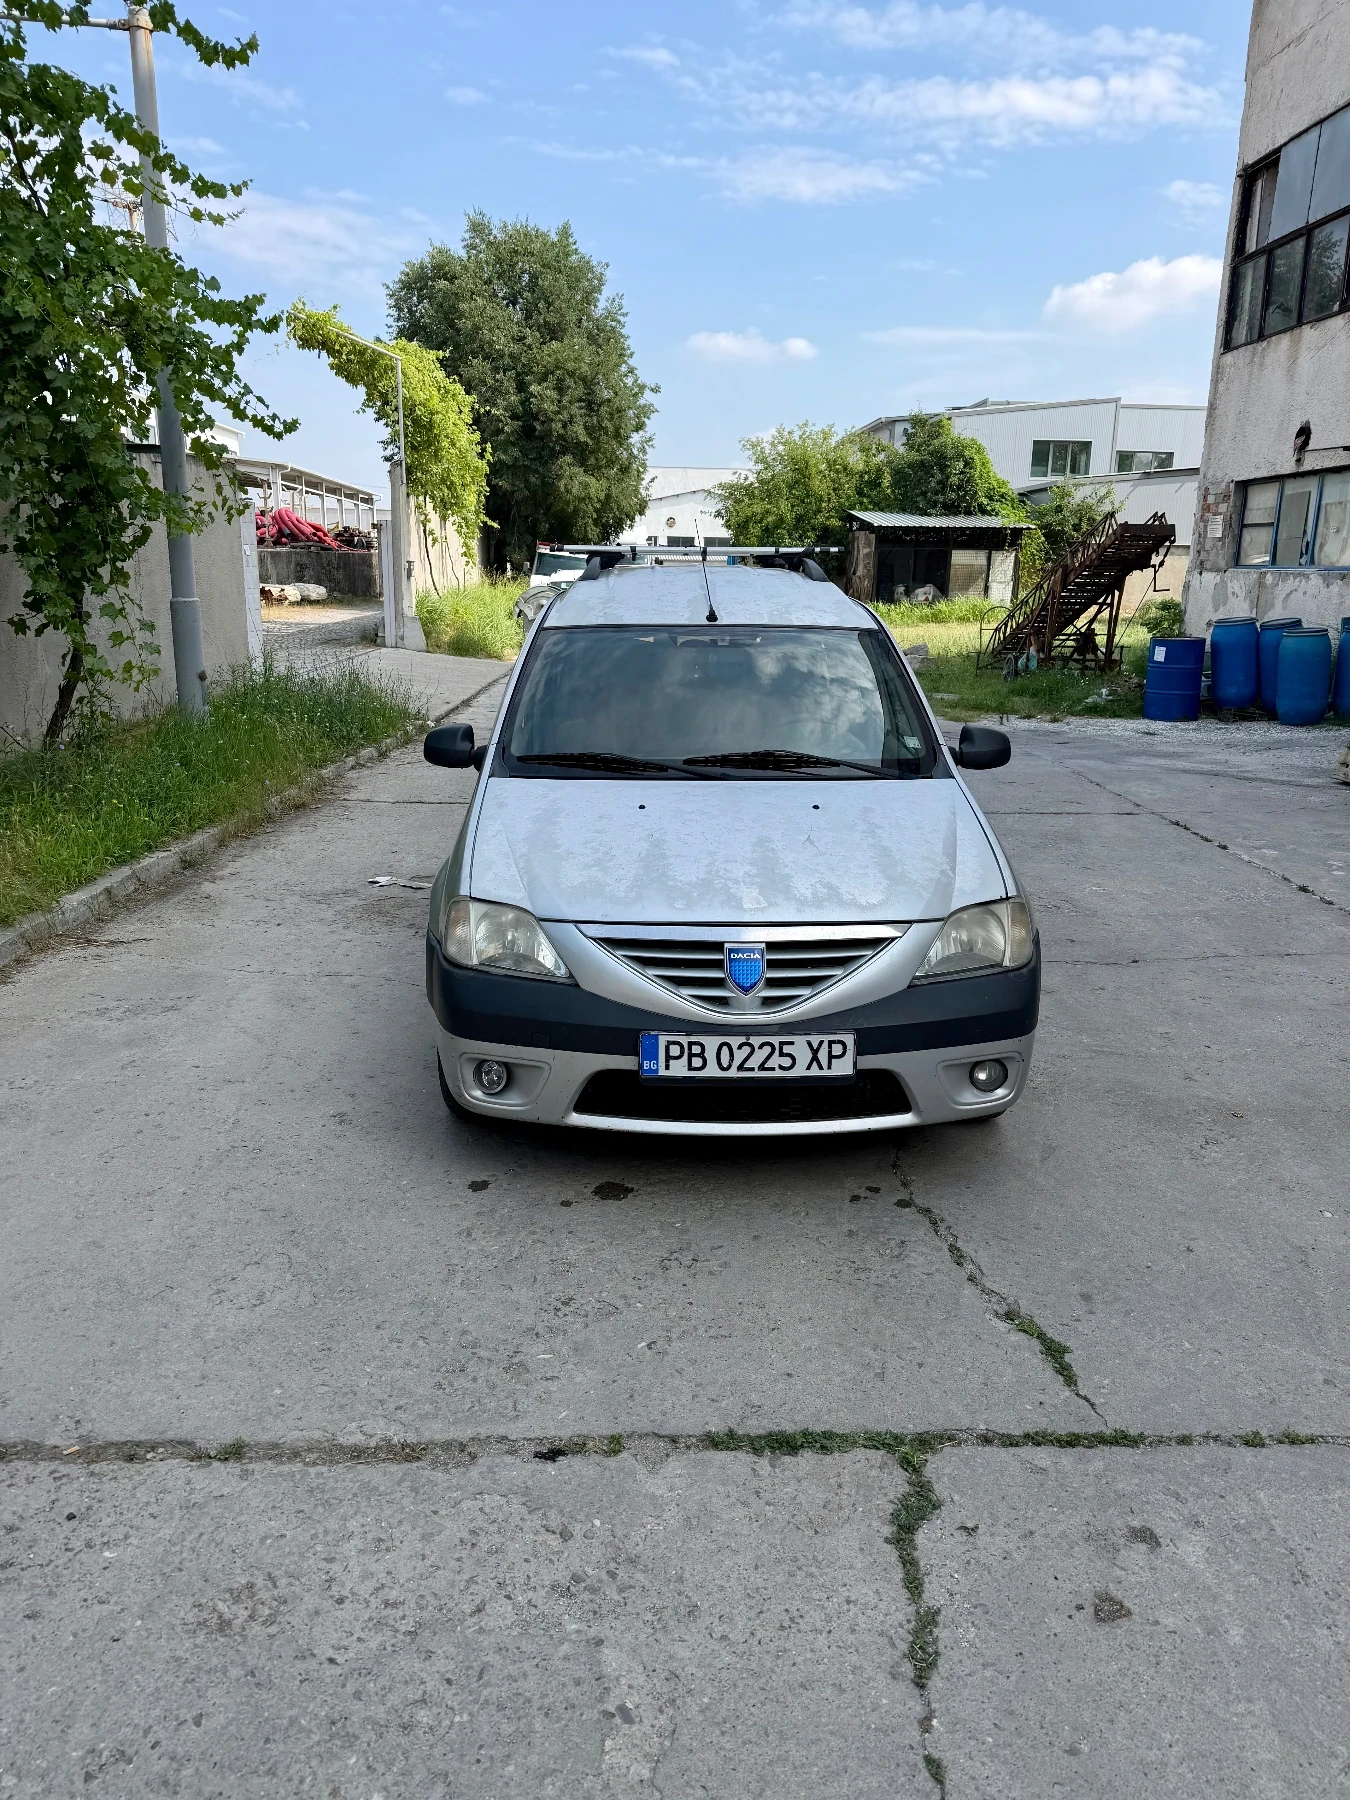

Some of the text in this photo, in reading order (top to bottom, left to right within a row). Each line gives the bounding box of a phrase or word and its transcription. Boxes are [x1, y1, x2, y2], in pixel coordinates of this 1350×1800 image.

[643, 1060, 658, 1070] BG
[664, 1039, 848, 1072] PB 0225 XP
